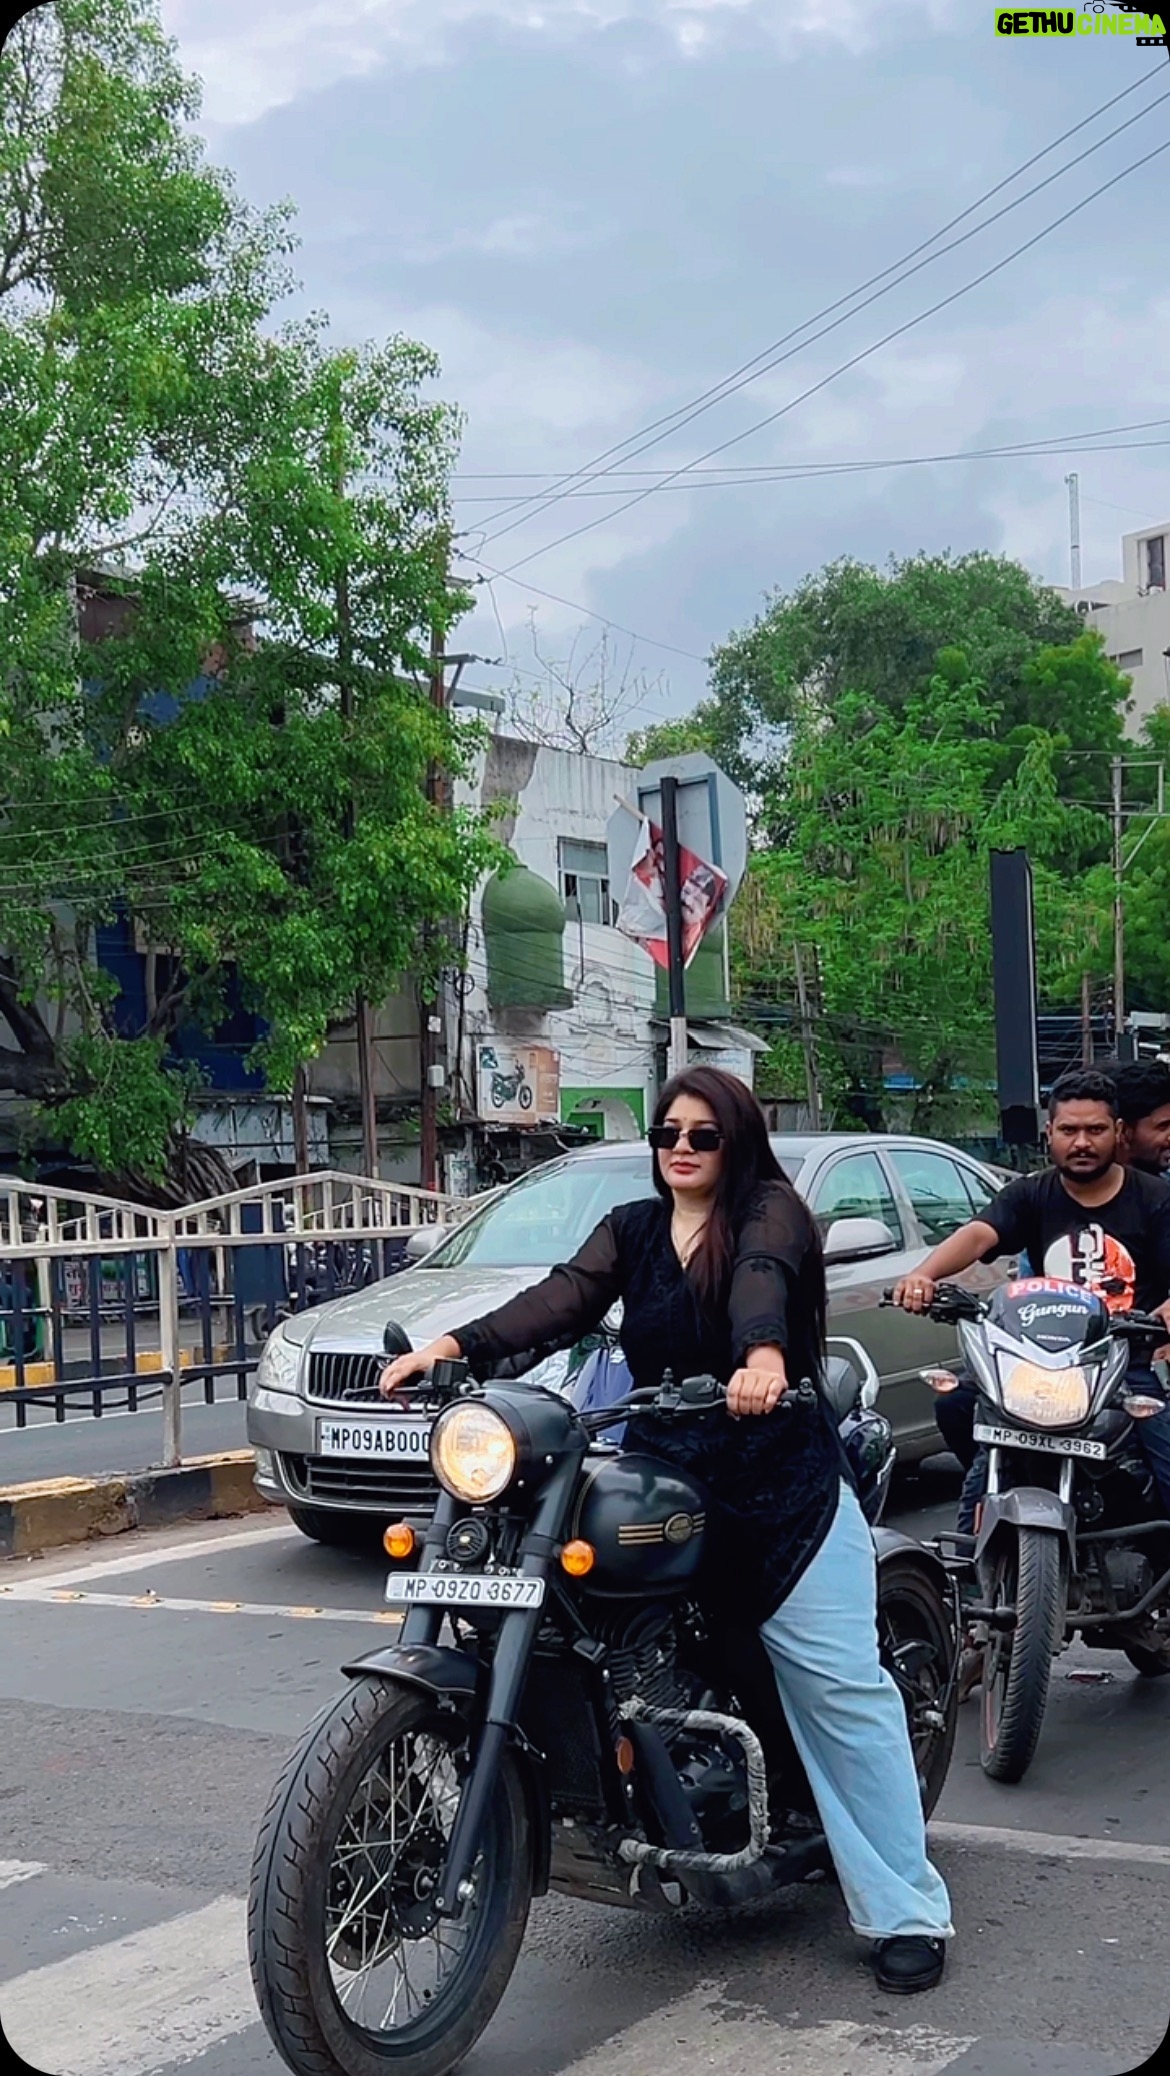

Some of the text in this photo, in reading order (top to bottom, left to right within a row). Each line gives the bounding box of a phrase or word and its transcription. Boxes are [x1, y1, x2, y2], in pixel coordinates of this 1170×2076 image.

[1009, 1280, 1092, 1304] POLICE
[1017, 1303, 1089, 1328] Gungun
[993, 1429, 1012, 1442] MP
[404, 1579, 427, 1598] MP
[491, 1581, 538, 1603] 3677
